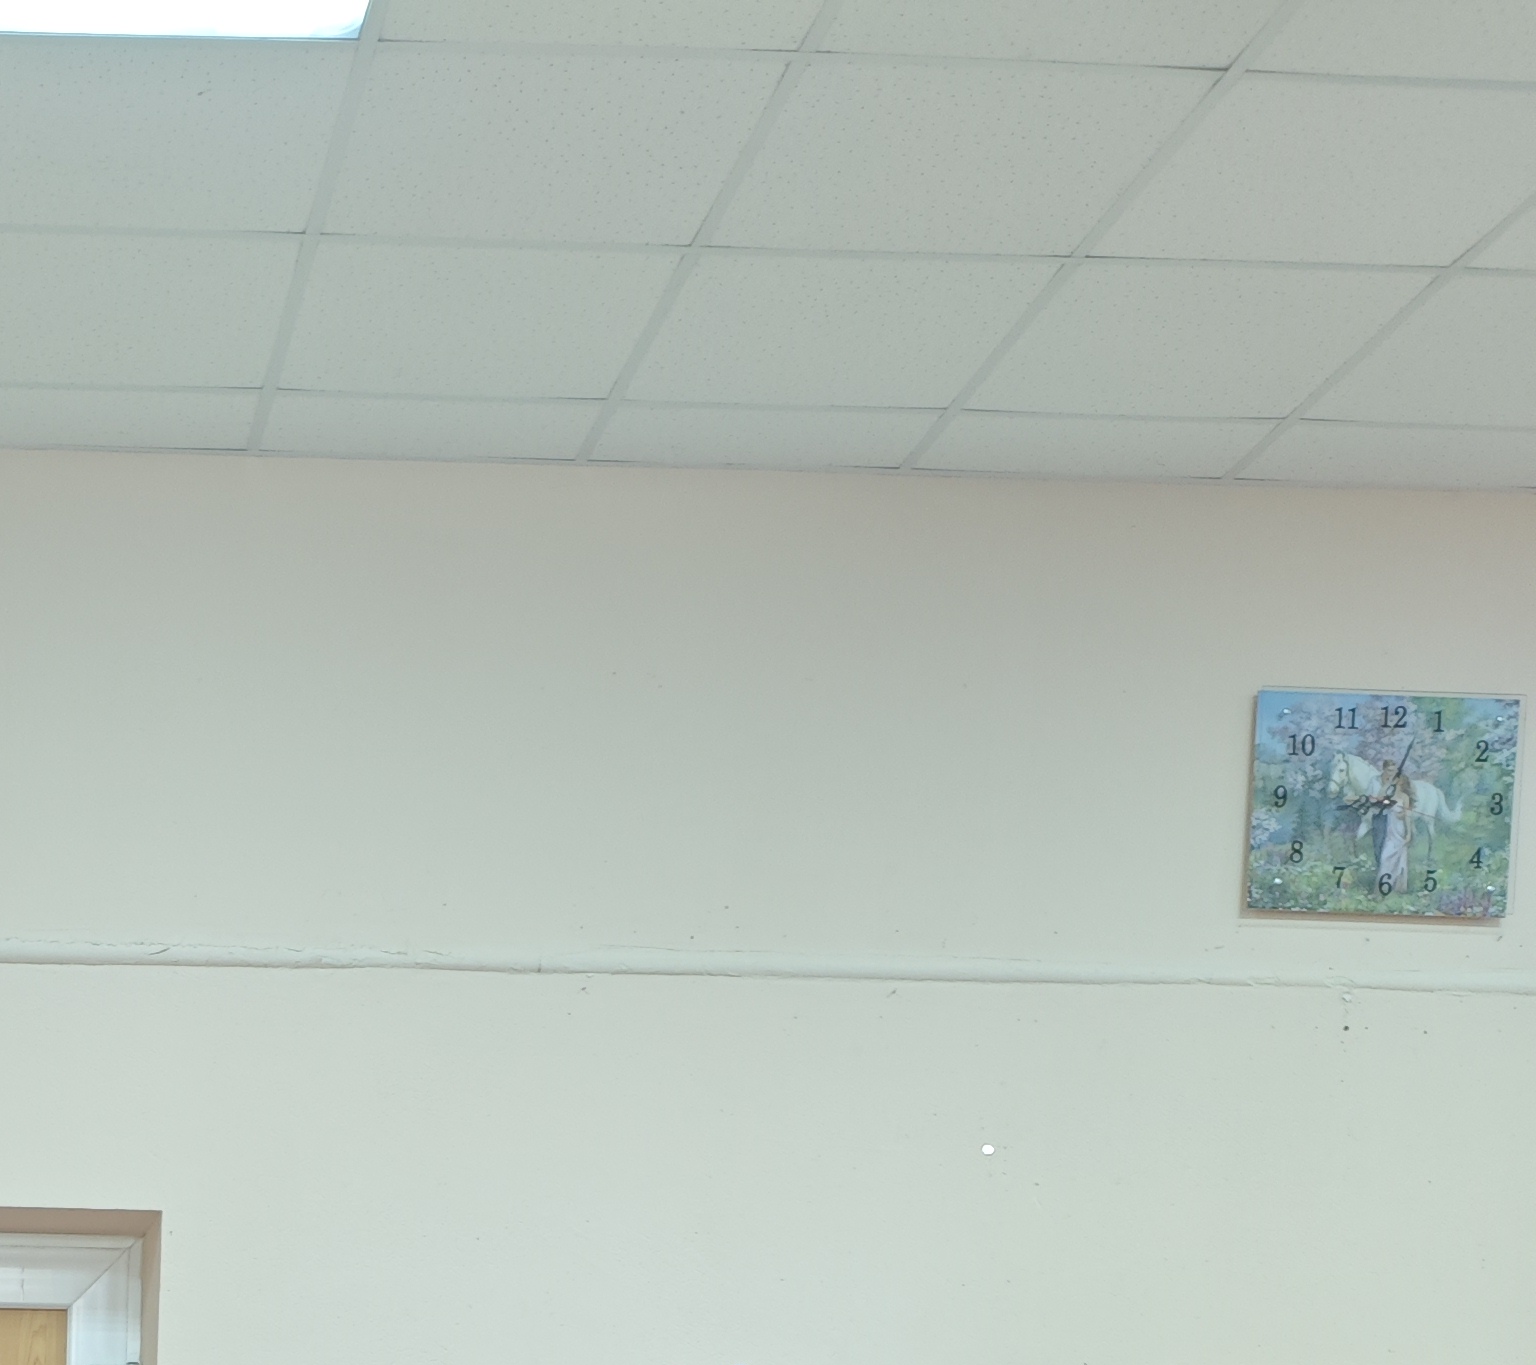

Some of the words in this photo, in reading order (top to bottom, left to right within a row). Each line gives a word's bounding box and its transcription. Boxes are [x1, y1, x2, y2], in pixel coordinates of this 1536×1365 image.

[1335, 707, 1358, 729] 11
[1381, 705, 1407, 728] 12
[1434, 710, 1444, 732] 1
[1288, 734, 1315, 756] 10
[1475, 740, 1489, 762] 2
[1274, 785, 1287, 807] 9
[1490, 793, 1503, 815] 3
[1289, 840, 1303, 863] 8
[1469, 847, 1483, 868] 4
[1332, 866, 1345, 888] 7
[1378, 873, 1392, 895] 6
[1424, 870, 1437, 892] 5
